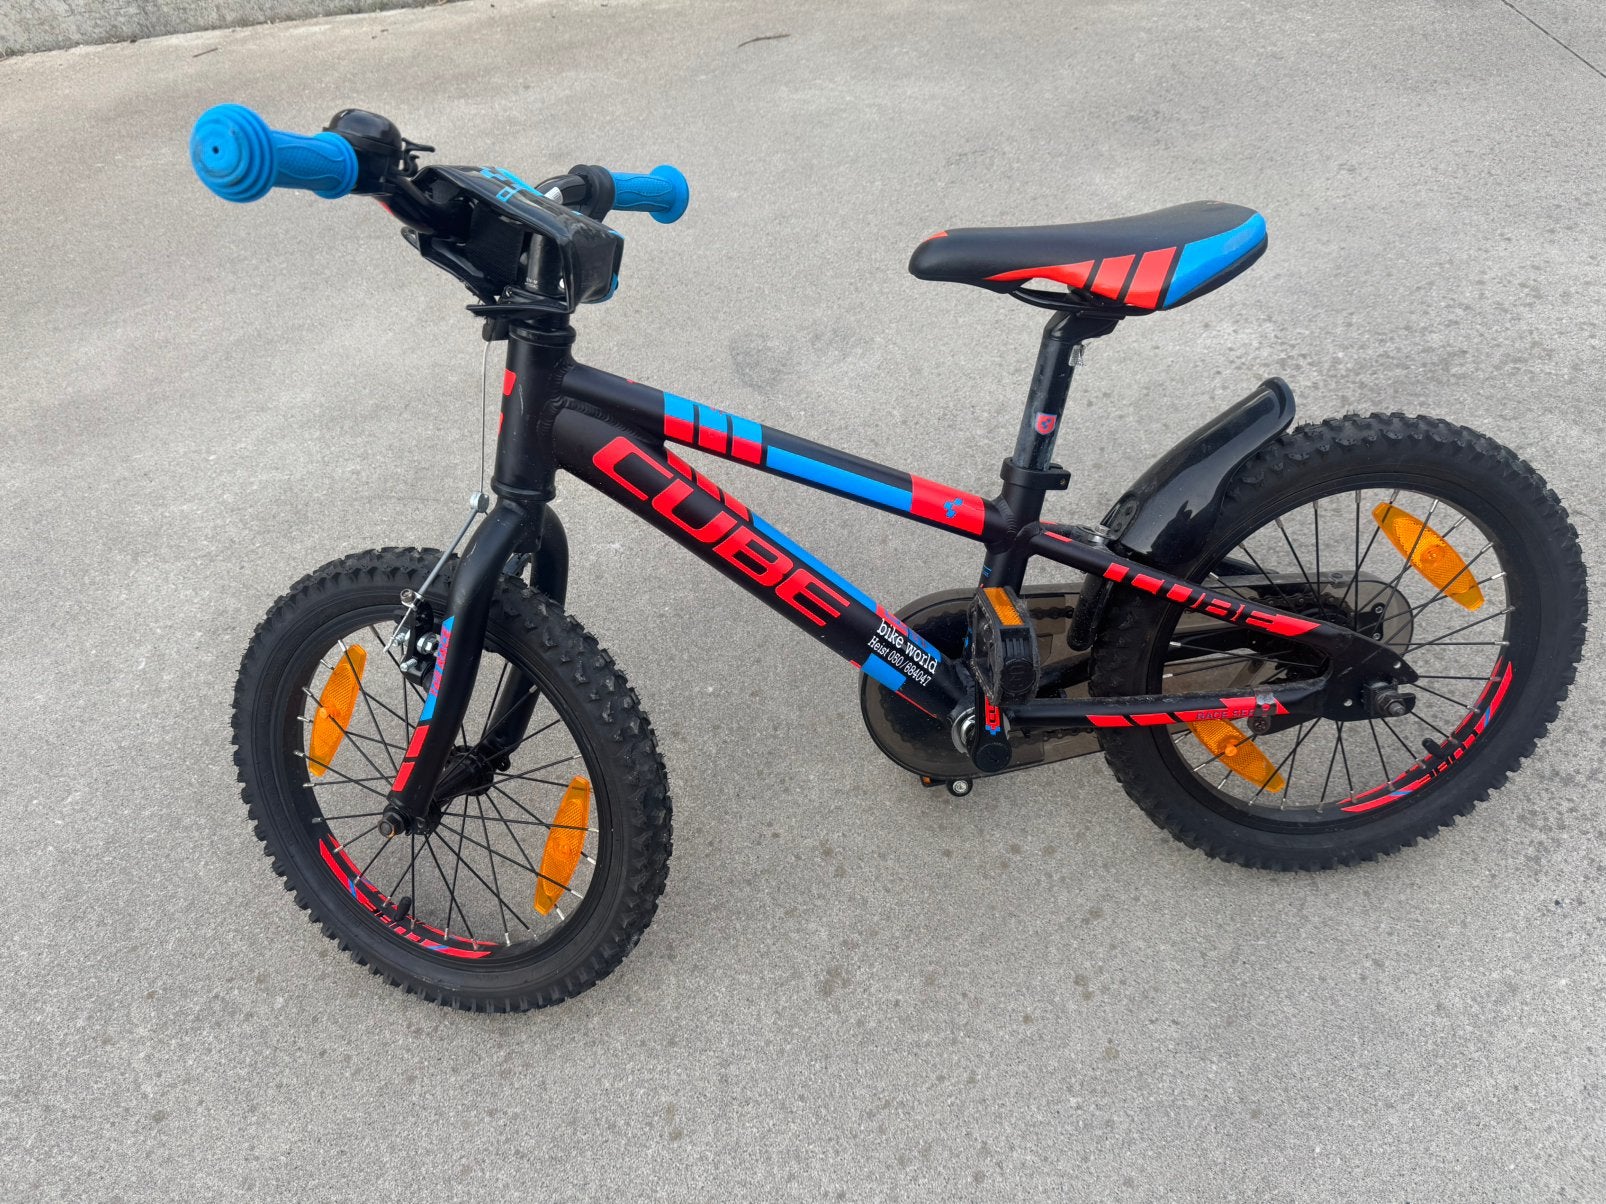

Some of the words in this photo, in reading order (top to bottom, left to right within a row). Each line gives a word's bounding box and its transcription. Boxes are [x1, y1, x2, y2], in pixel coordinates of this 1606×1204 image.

[592, 436, 851, 627] CUBE
[867, 635, 890, 658] Heist
[887, 650, 932, 687] 050/684047
[877, 618, 904, 649] bike
[905, 642, 938, 675] world
